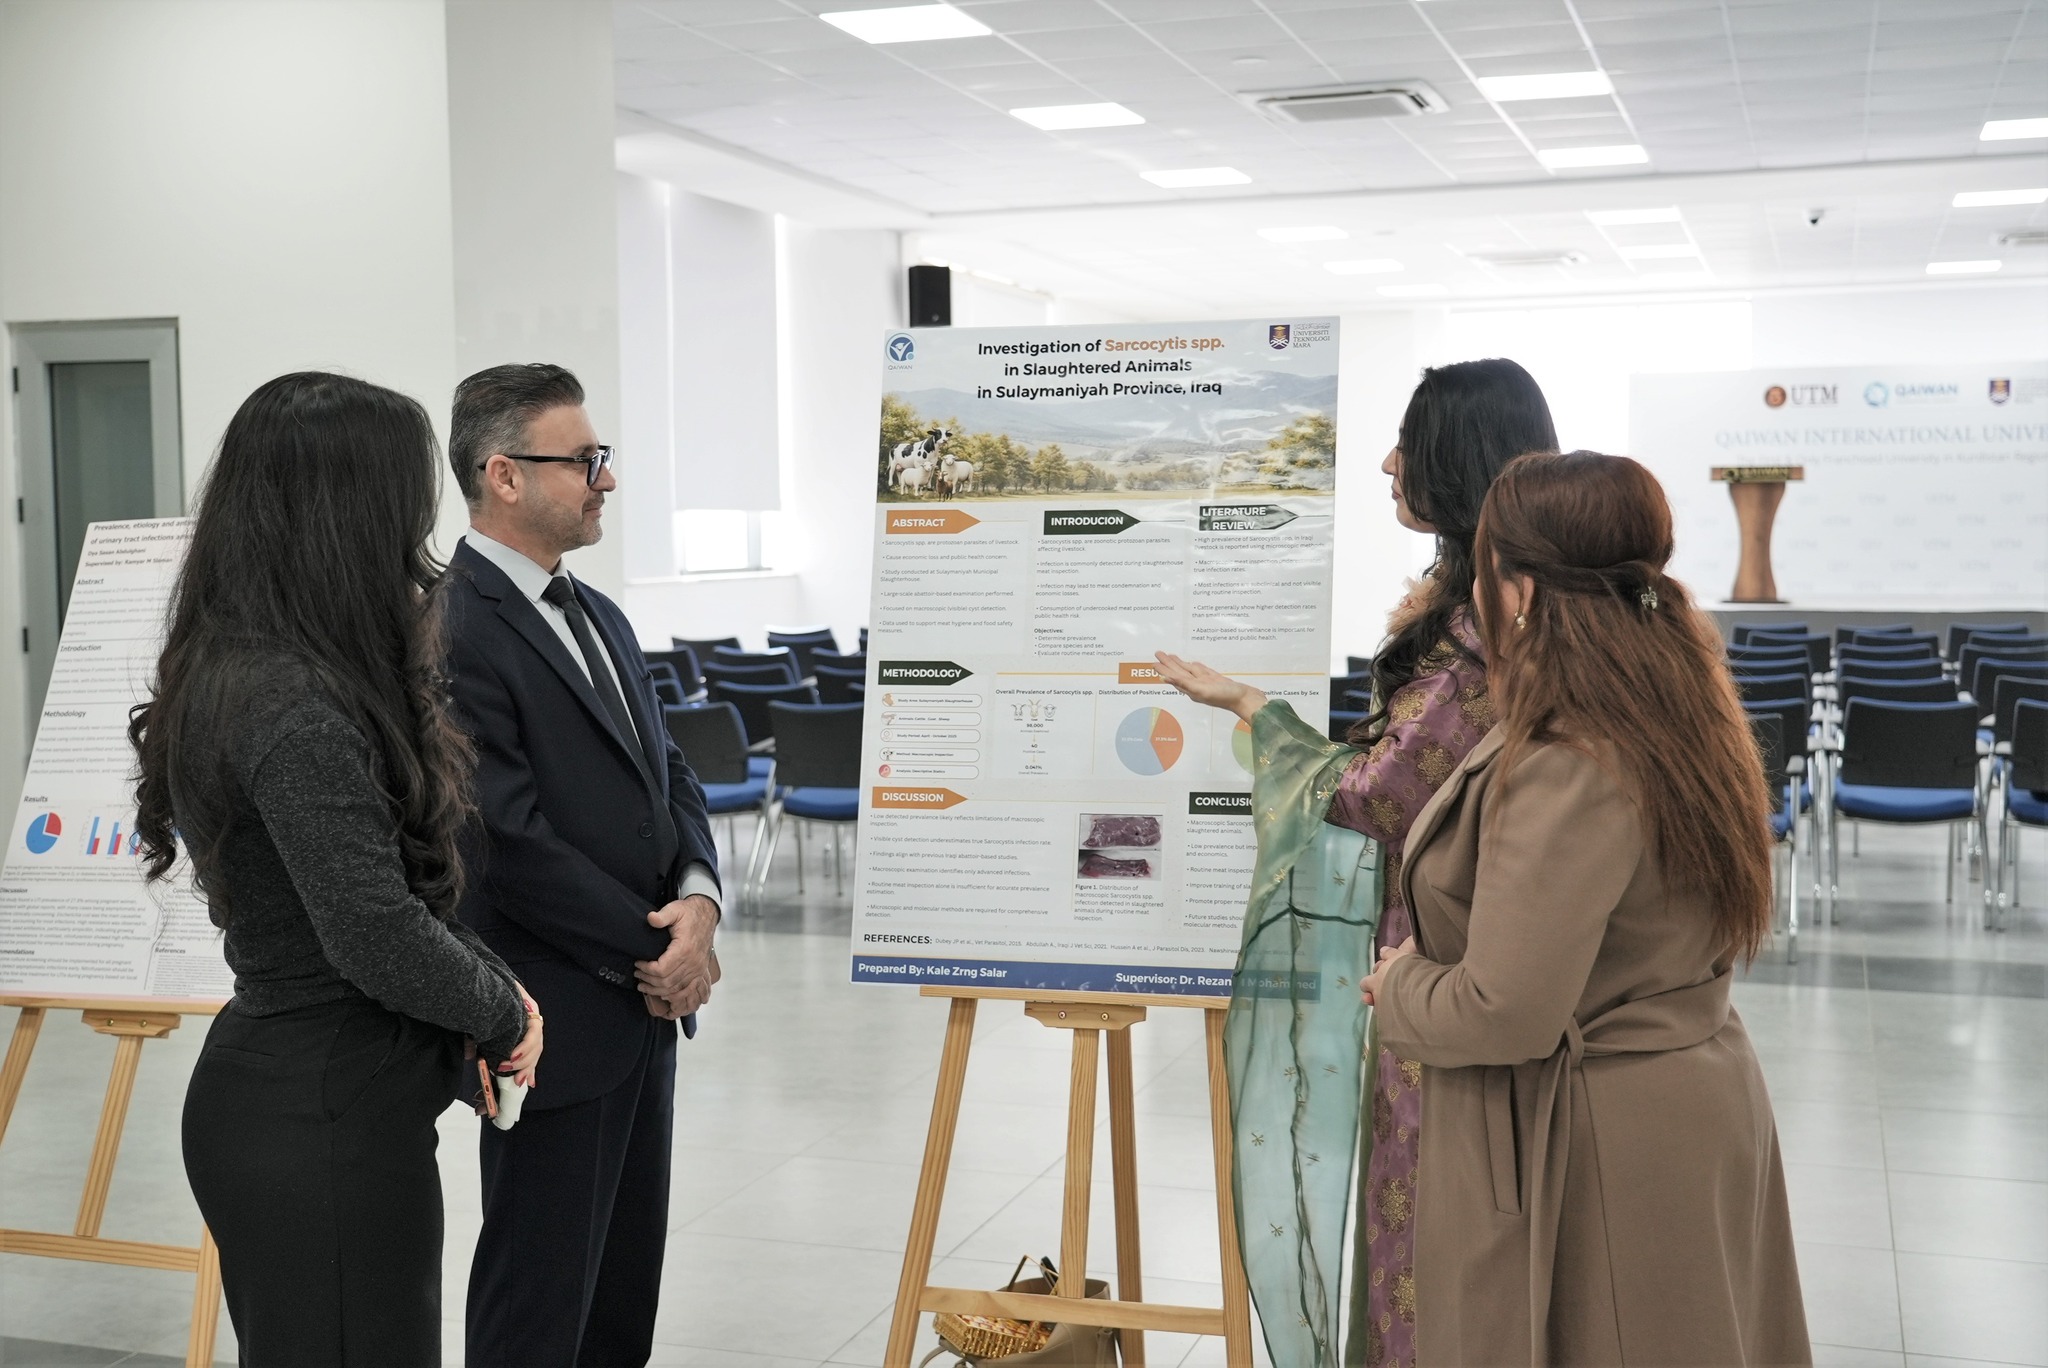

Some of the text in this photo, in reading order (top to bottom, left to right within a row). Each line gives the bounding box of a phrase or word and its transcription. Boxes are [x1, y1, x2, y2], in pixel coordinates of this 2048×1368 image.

[978, 335, 1225, 359] Investigation of Sarcocytis spp.
[1004, 357, 1192, 380] in Slaughtered Animals
[977, 379, 1222, 402] in Sulaymaniyah Province, Iraq
[1790, 385, 1838, 405] UTM
[1896, 384, 1958, 397] QAIWAN
[1715, 424, 2048, 448] QAIWAN INTERNATIONAL UNIVE
[1202, 507, 1266, 516] LITERATURE
[892, 519, 946, 527] ABSTRACT
[1051, 516, 1124, 526] INTRODUCION
[1212, 521, 1256, 530] REVIEW
[882, 668, 962, 678] METHODOLOGY
[1130, 668, 1160, 677] RESU
[44, 710, 86, 718] Methodology
[882, 793, 944, 802] DISCUSSION
[1195, 797, 1252, 806] CONCLUSI
[864, 934, 932, 944] REFERENCES:
[858, 962, 1007, 979] Prepared By: Kale Zrng Salar
[1116, 972, 1178, 987] Supervisor:
[1179, 974, 1196, 985] Dr.
[1197, 975, 1232, 986] Rezan
